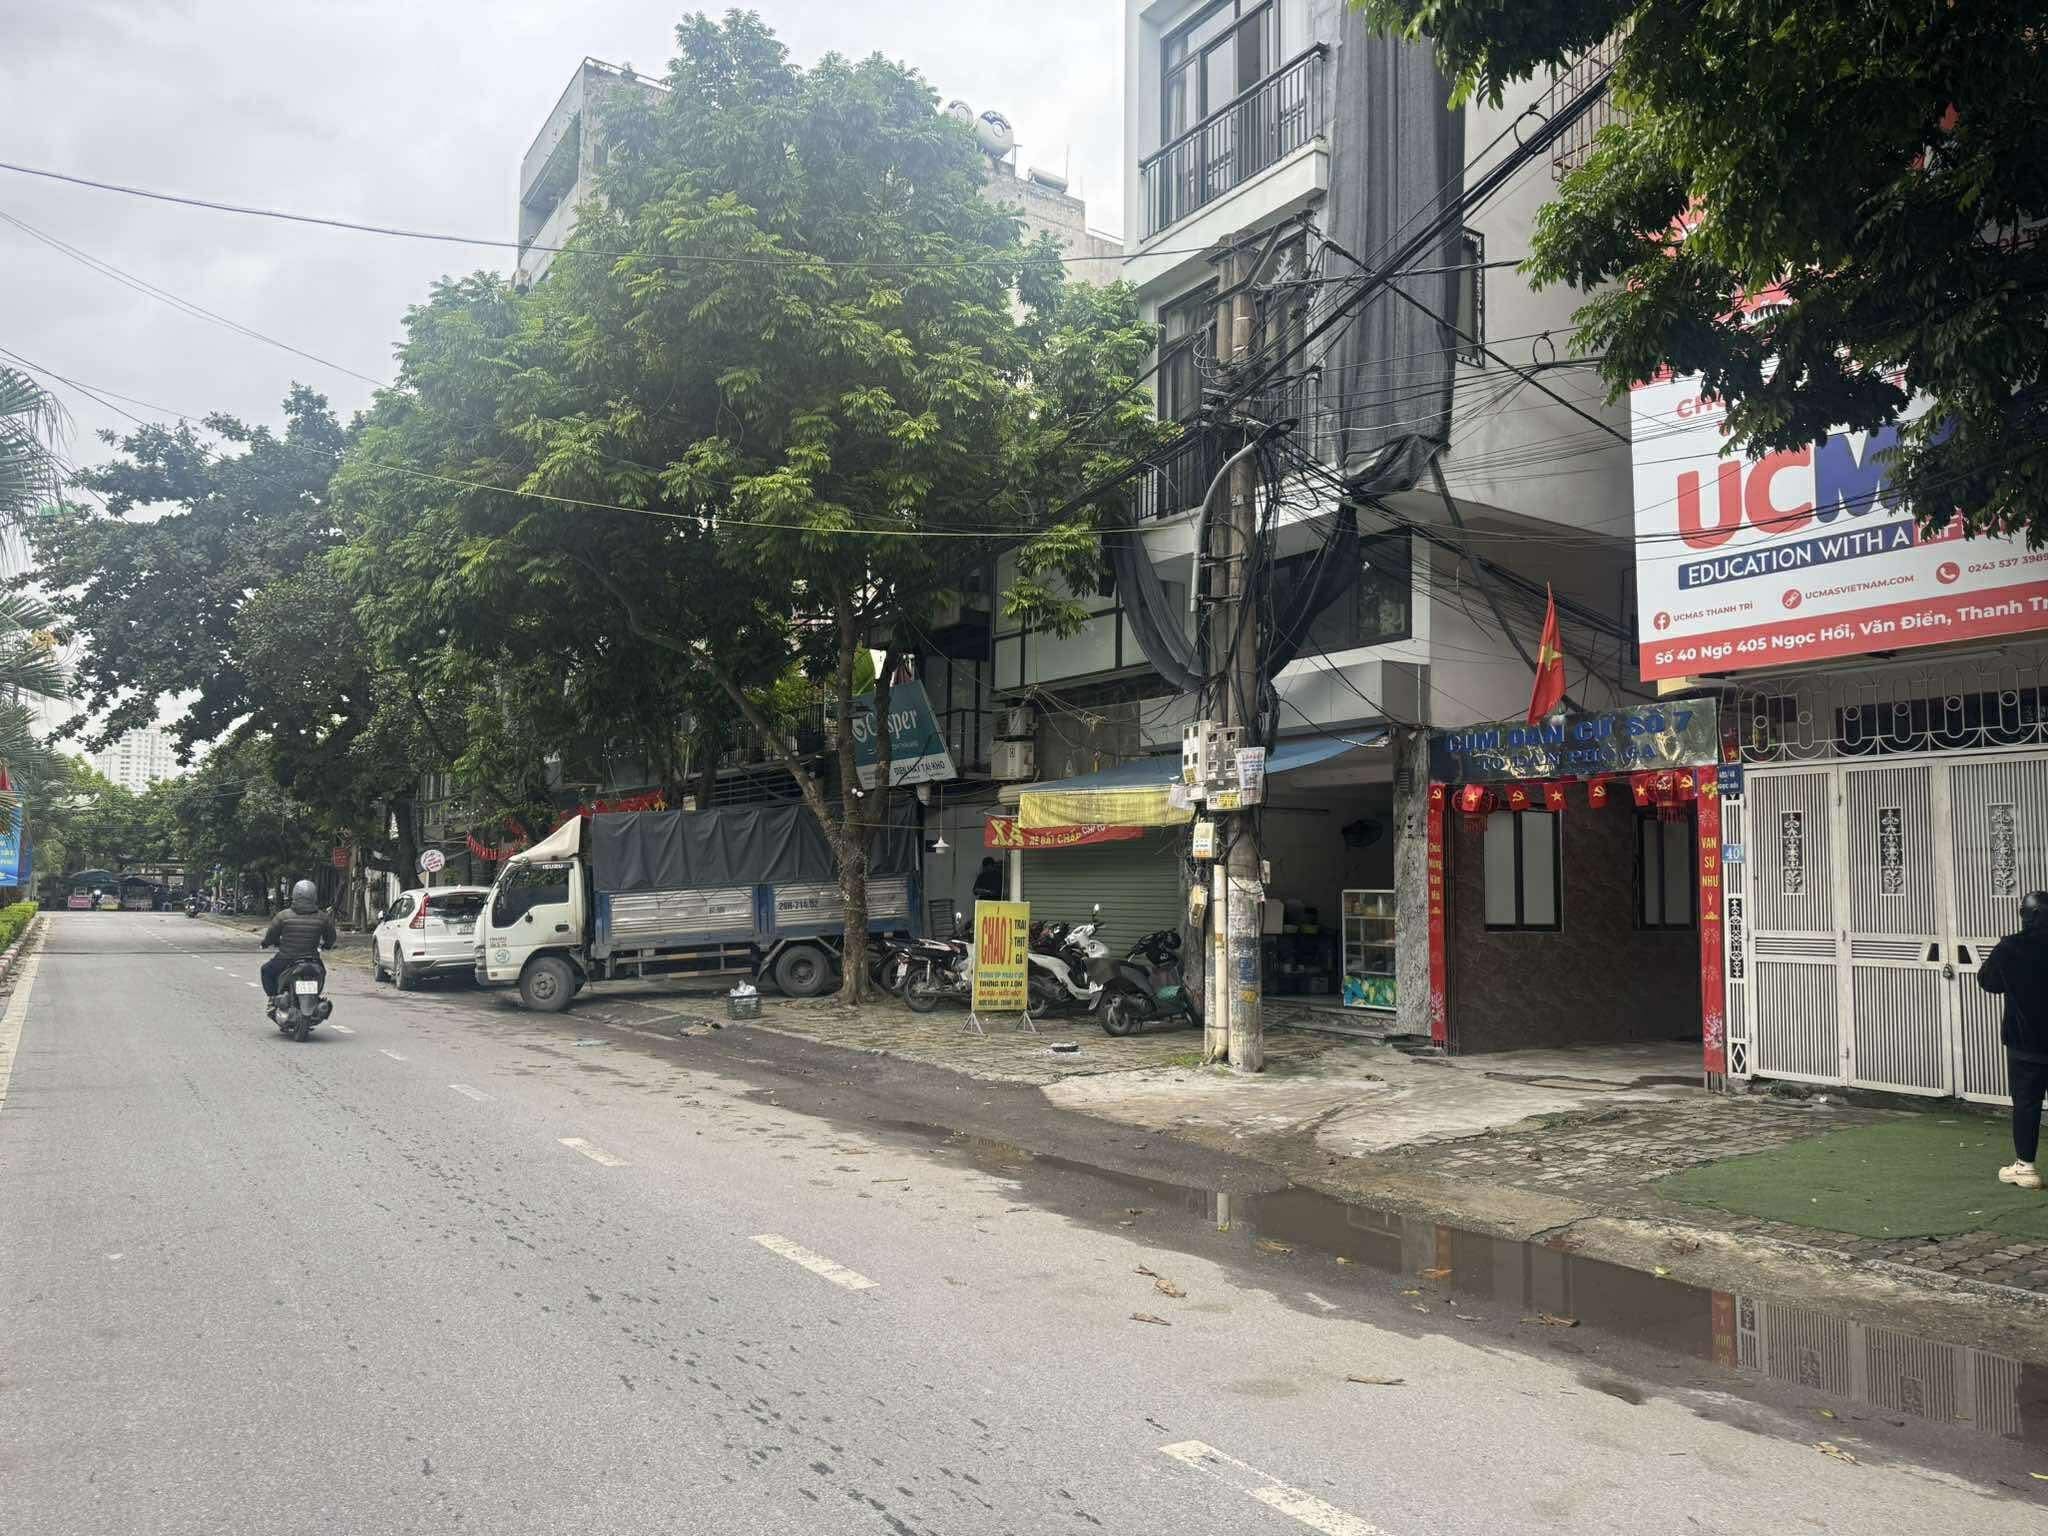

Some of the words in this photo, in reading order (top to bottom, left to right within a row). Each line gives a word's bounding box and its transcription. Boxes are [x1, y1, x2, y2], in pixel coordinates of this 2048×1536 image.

[1688, 547, 1812, 586] EDUCATION
[1818, 528, 1883, 560] WITH
[1891, 526, 1911, 548] A
[1968, 561, 1995, 573] 0243
[1998, 558, 2018, 568] 537
[1805, 575, 1914, 600] UCMASVIETNAM.COM
[1673, 610, 1704, 622] UCMAS
[1706, 605, 1737, 616] THANH
[1655, 647, 1673, 665] Số
[1677, 648, 1697, 661] 40
[1701, 641, 1731, 660] Ngõ
[1737, 637, 1767, 653] 405
[1771, 630, 1816, 650] Ngọc
[1820, 623, 1856, 641] Hồi,
[1860, 618, 1895, 636] Văn
[1900, 609, 1953, 630] Điển,
[1957, 599, 2023, 622] Thanh
[2028, 596, 2048, 612] Tr
[865, 709, 918, 740] Csper
[1672, 711, 1695, 731] 7
[1725, 847, 1740, 860] 40
[981, 906, 1007, 966] CHÁO
